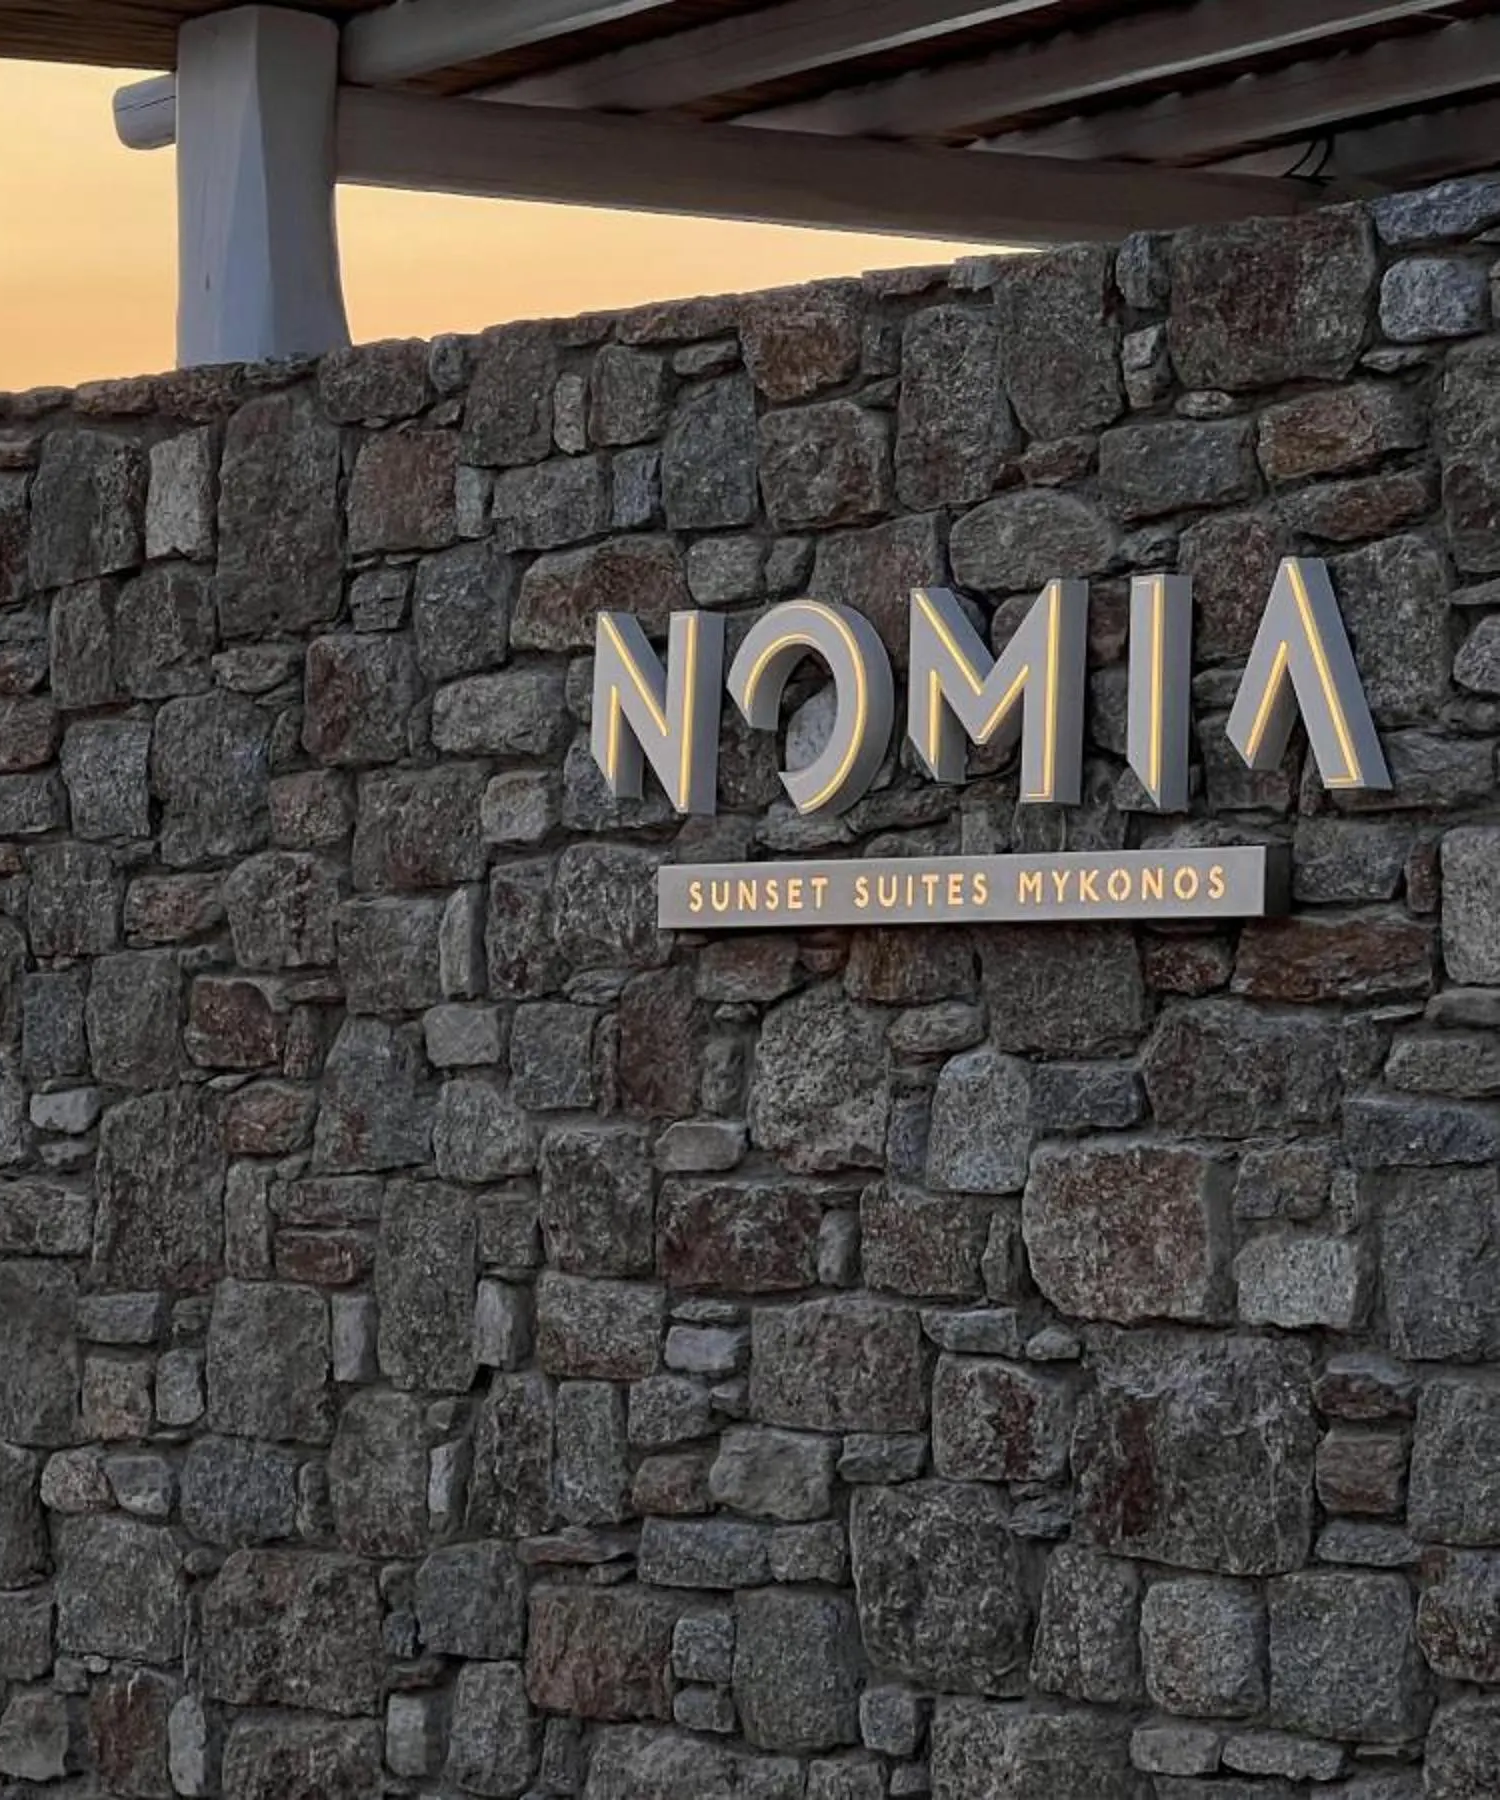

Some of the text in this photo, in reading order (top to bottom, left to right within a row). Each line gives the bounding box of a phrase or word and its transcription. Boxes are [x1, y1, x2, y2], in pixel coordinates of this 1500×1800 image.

[591, 557, 1392, 815] NOMIA
[688, 864, 1227, 913] SUNSET SUITES MYKONOS
